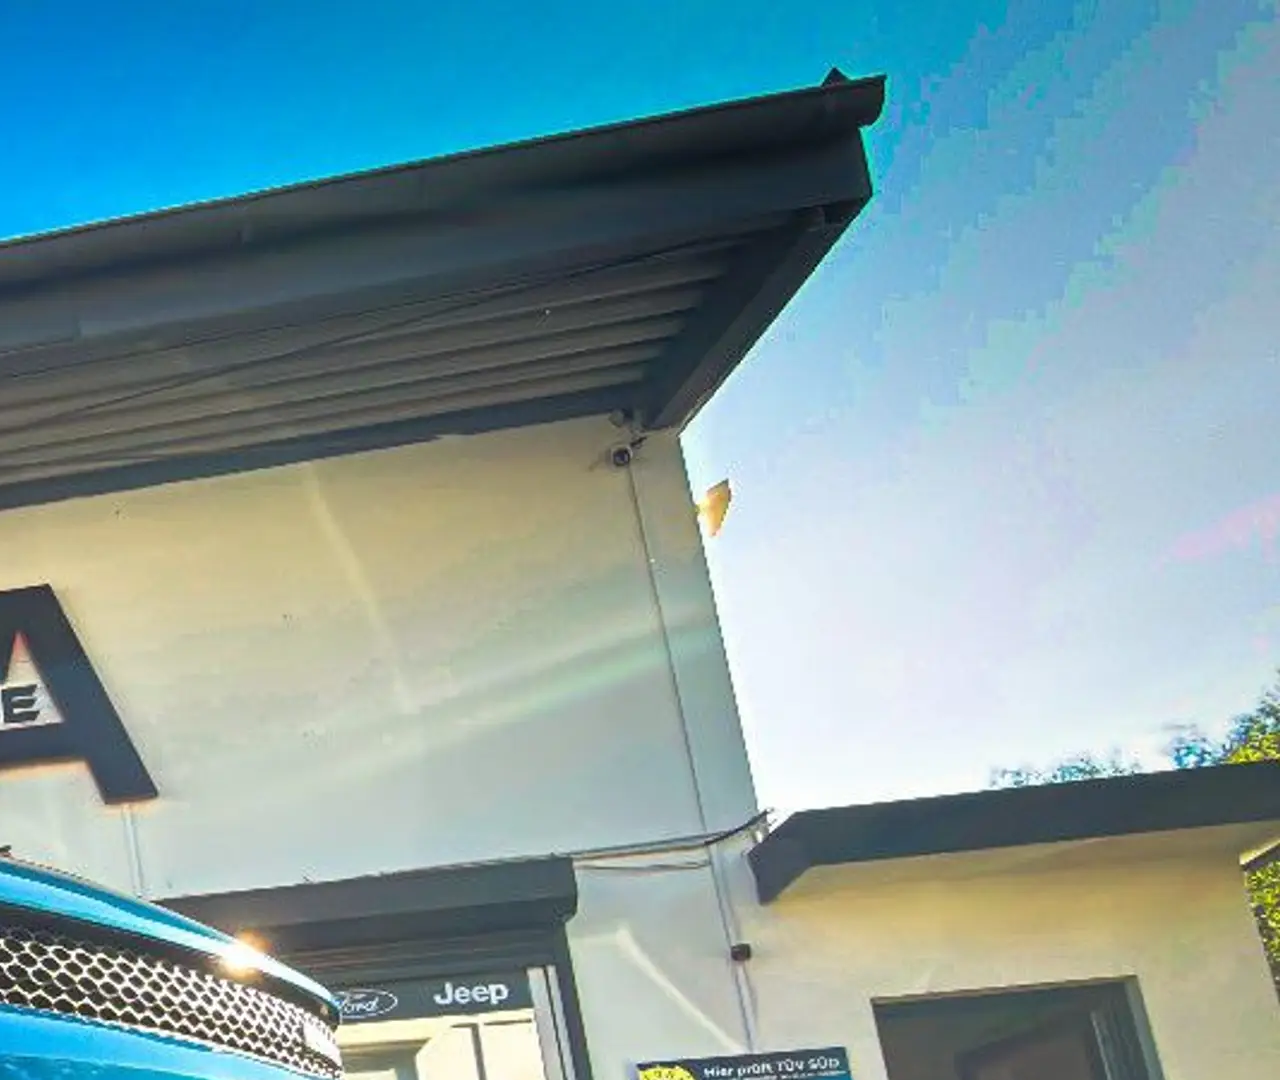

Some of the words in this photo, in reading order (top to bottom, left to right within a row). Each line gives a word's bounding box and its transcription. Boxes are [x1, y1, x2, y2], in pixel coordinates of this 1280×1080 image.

[434, 982, 508, 1004] Jeep
[703, 1066, 733, 1078] Hier
[776, 1058, 805, 1072] TÜV
[807, 1055, 841, 1070] SÜD
